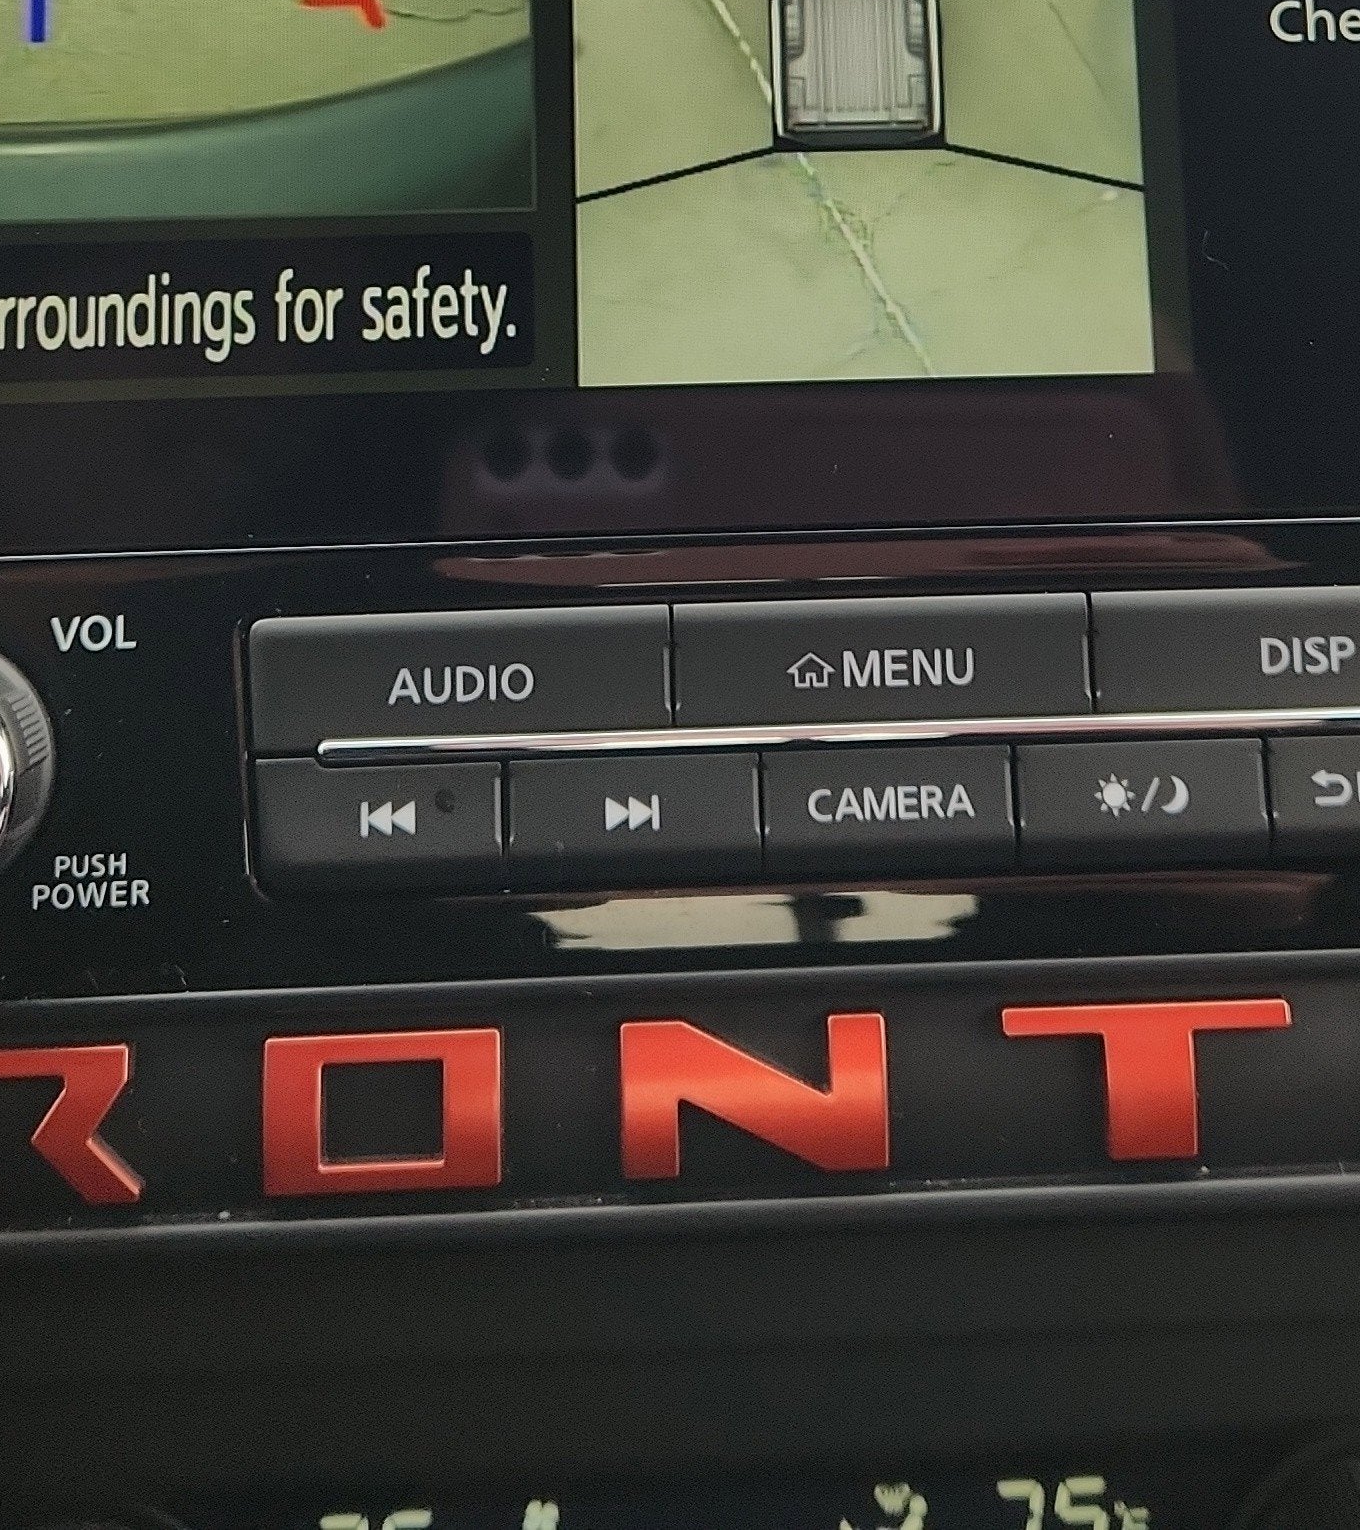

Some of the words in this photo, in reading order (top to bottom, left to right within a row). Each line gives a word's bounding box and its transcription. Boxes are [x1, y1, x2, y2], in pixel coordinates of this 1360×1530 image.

[273, 268, 344, 344] for
[360, 264, 518, 356] safety.
[49, 613, 138, 653] VOL
[841, 648, 977, 689] MENU
[1257, 635, 1358, 678] DISP
[388, 661, 536, 705] AUDIO
[807, 783, 976, 824] CAMERA
[53, 851, 128, 879] PUSH
[30, 878, 151, 911] POWER
